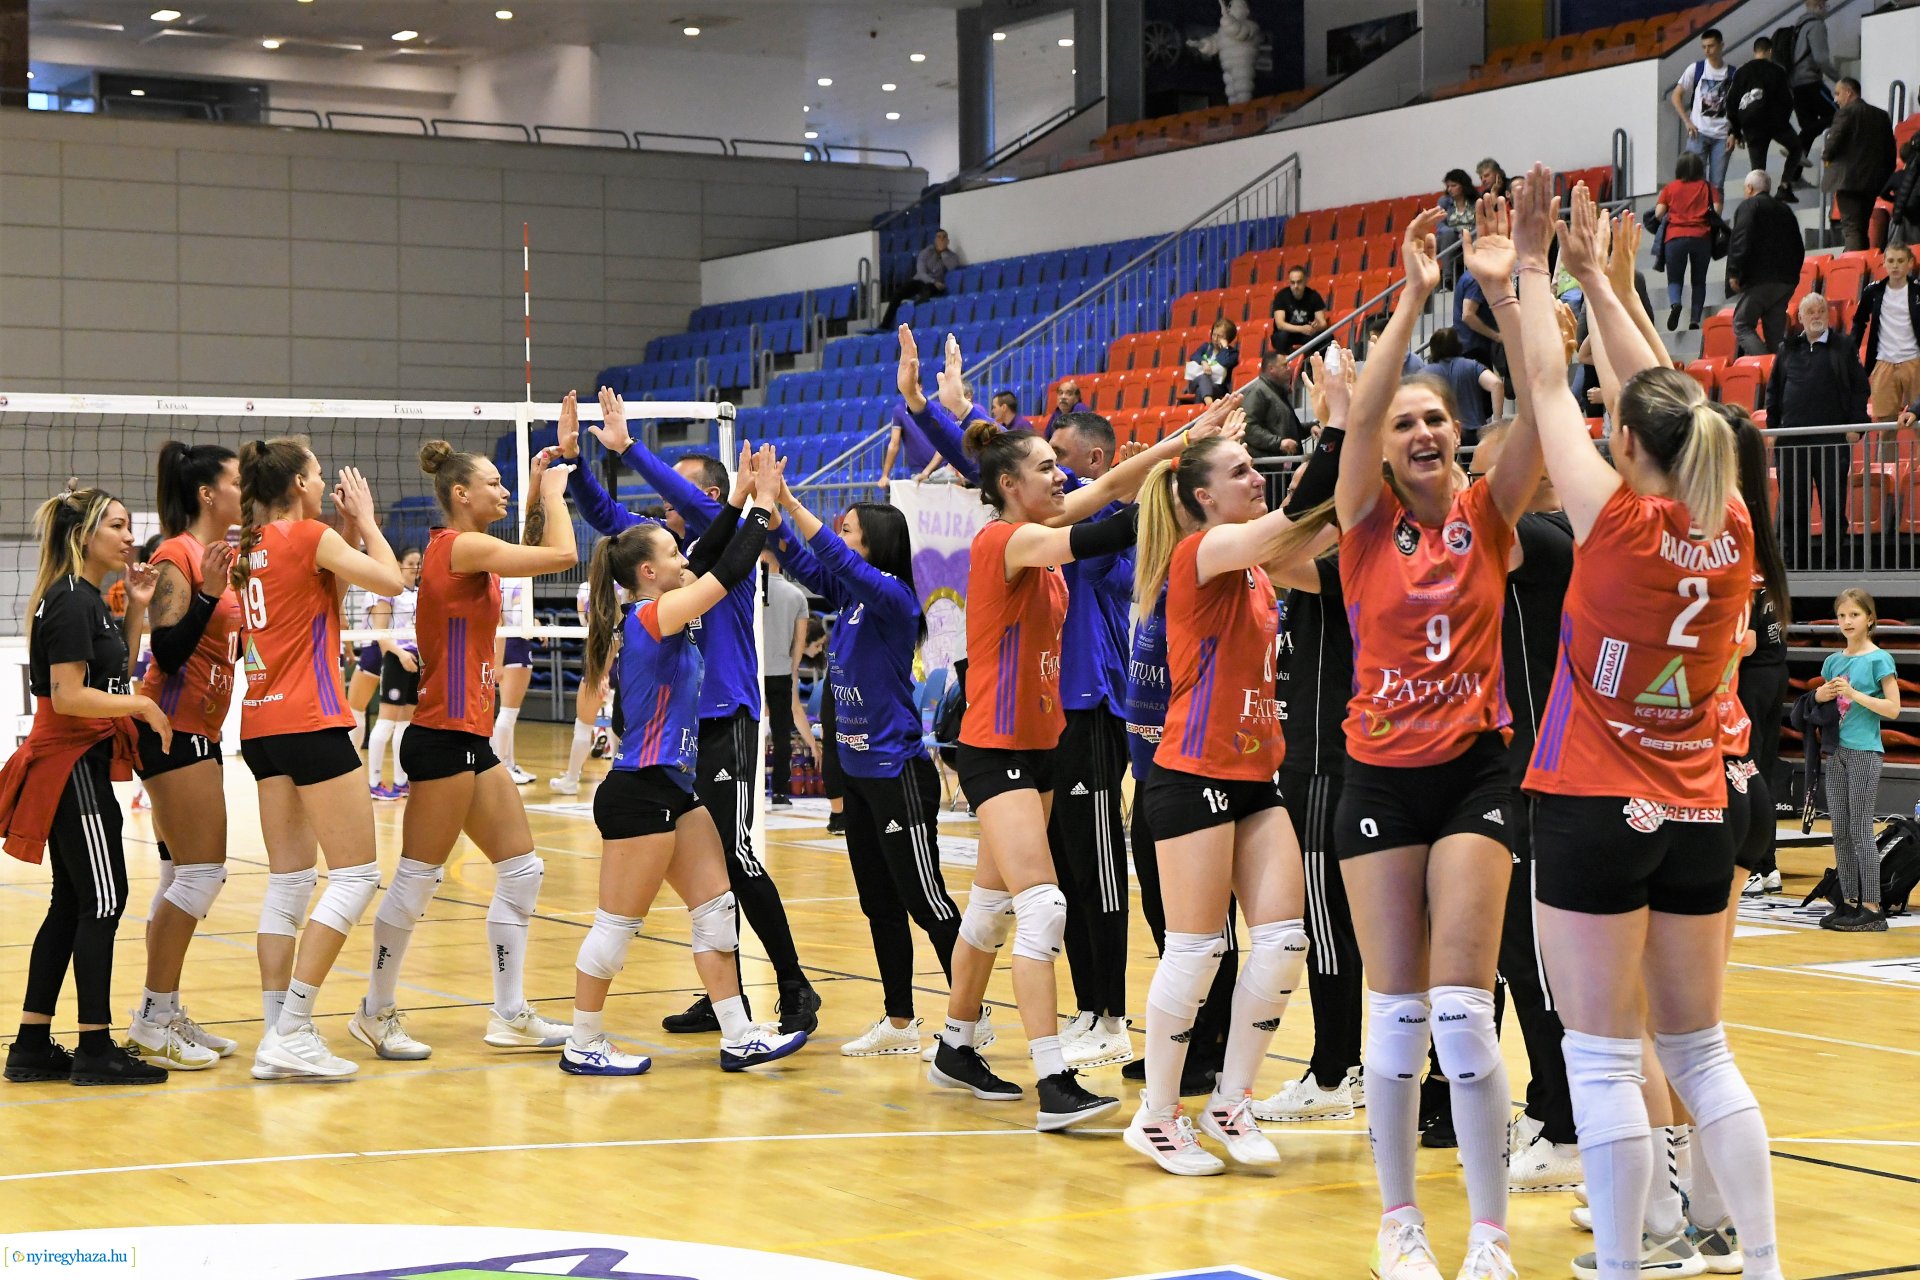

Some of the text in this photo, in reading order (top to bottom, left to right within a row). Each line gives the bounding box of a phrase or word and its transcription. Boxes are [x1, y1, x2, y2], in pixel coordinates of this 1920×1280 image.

[917, 509, 976, 538] HAJRÁ
[240, 577, 267, 630] 19
[1666, 576, 1710, 648] 2
[1425, 614, 1451, 662] 9
[1372, 667, 1483, 703] FATUM
[1600, 642, 1620, 693] STRABAG
[1634, 705, 1680, 720] KE-VIZ
[190, 734, 209, 757] 17
[1639, 736, 1715, 751] BESTRONG
